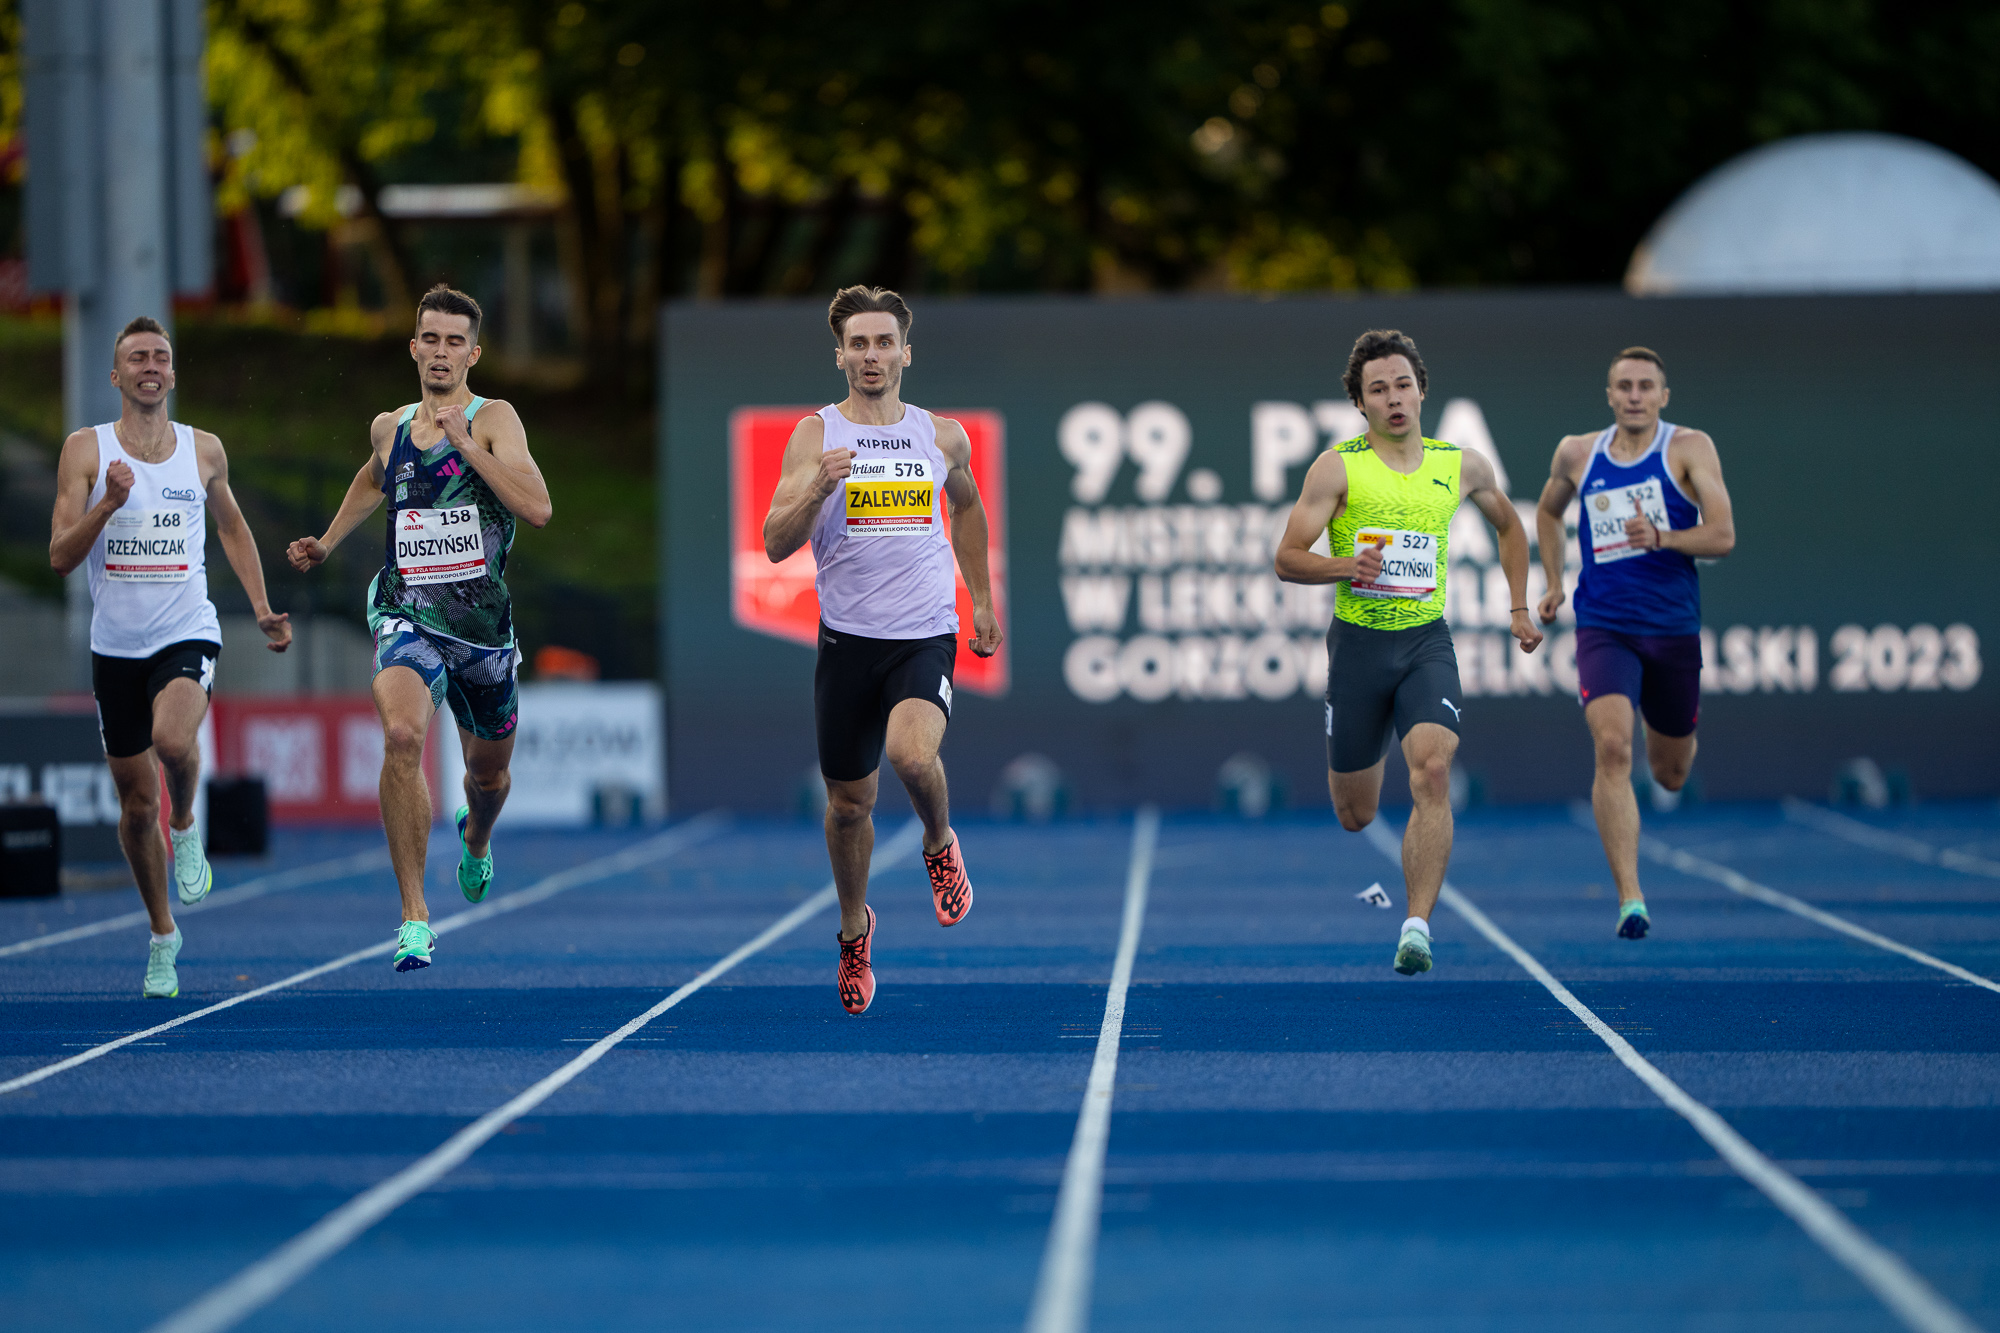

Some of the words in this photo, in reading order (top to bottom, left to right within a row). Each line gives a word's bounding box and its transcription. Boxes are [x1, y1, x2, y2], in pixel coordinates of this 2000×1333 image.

[857, 439, 911, 450] KIPRUN
[1058, 402, 1223, 502] 99.
[852, 464, 885, 474] Artisan
[895, 463, 924, 477] 578
[850, 490, 930, 508] ZALEWSKI
[1626, 487, 1654, 504] 552
[153, 513, 180, 527] 168
[440, 510, 471, 525] 158
[107, 537, 185, 555] RZEŹNICZAK
[399, 534, 479, 558] DUSZYŃSKI
[1403, 535, 1429, 549] 527
[428, 571, 469, 580] WIELKOPOLSKI
[1831, 624, 1983, 693] 2023
